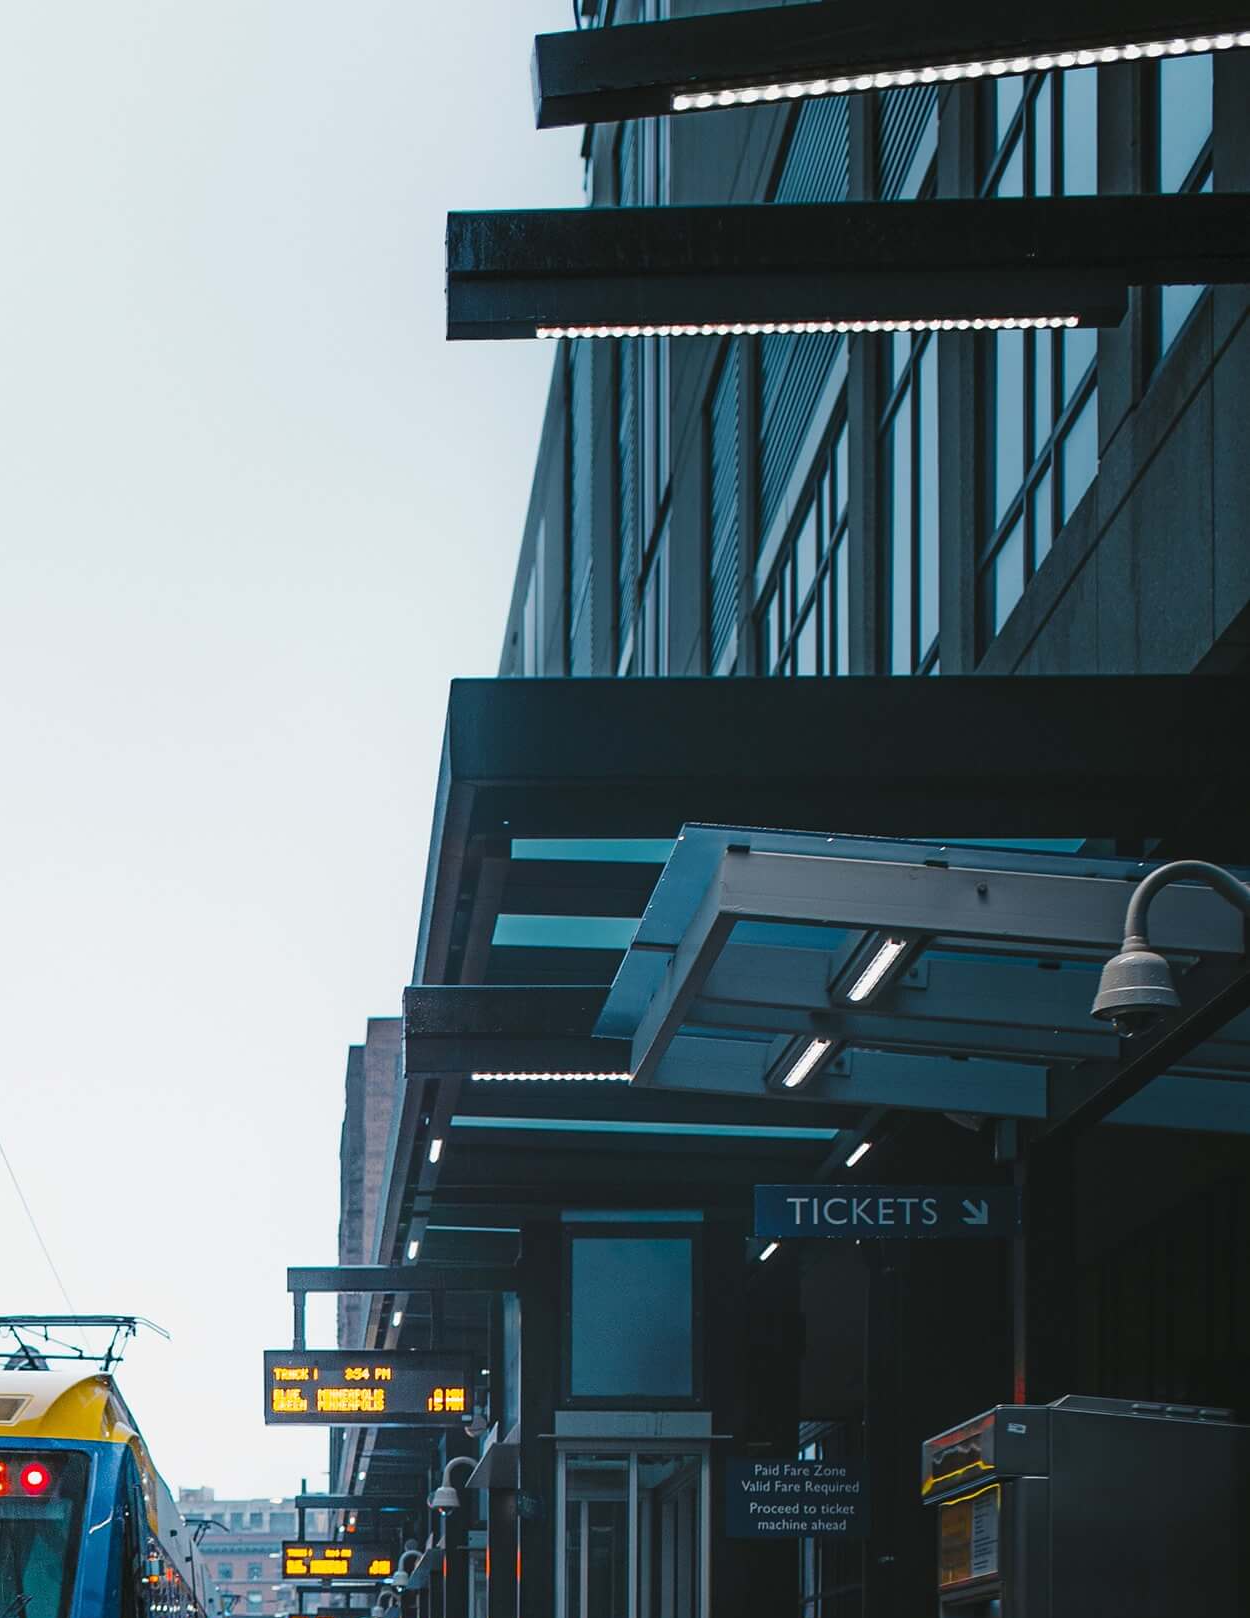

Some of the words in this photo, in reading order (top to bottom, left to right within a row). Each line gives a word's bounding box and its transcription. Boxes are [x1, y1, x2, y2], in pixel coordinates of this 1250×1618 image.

[786, 1197, 938, 1225] TICKETS
[374, 1367, 392, 1381] PM
[754, 1464, 780, 1476] Paid
[783, 1464, 810, 1476] Fare
[814, 1464, 847, 1476] Zone
[741, 1480, 770, 1492] Valid
[774, 1481, 801, 1492] Fare
[805, 1481, 860, 1495] Required
[749, 1502, 799, 1514] Proceed
[803, 1504, 817, 1514] to
[821, 1503, 855, 1514] ticket
[757, 1519, 808, 1530] machine
[811, 1519, 847, 1530] ahead
